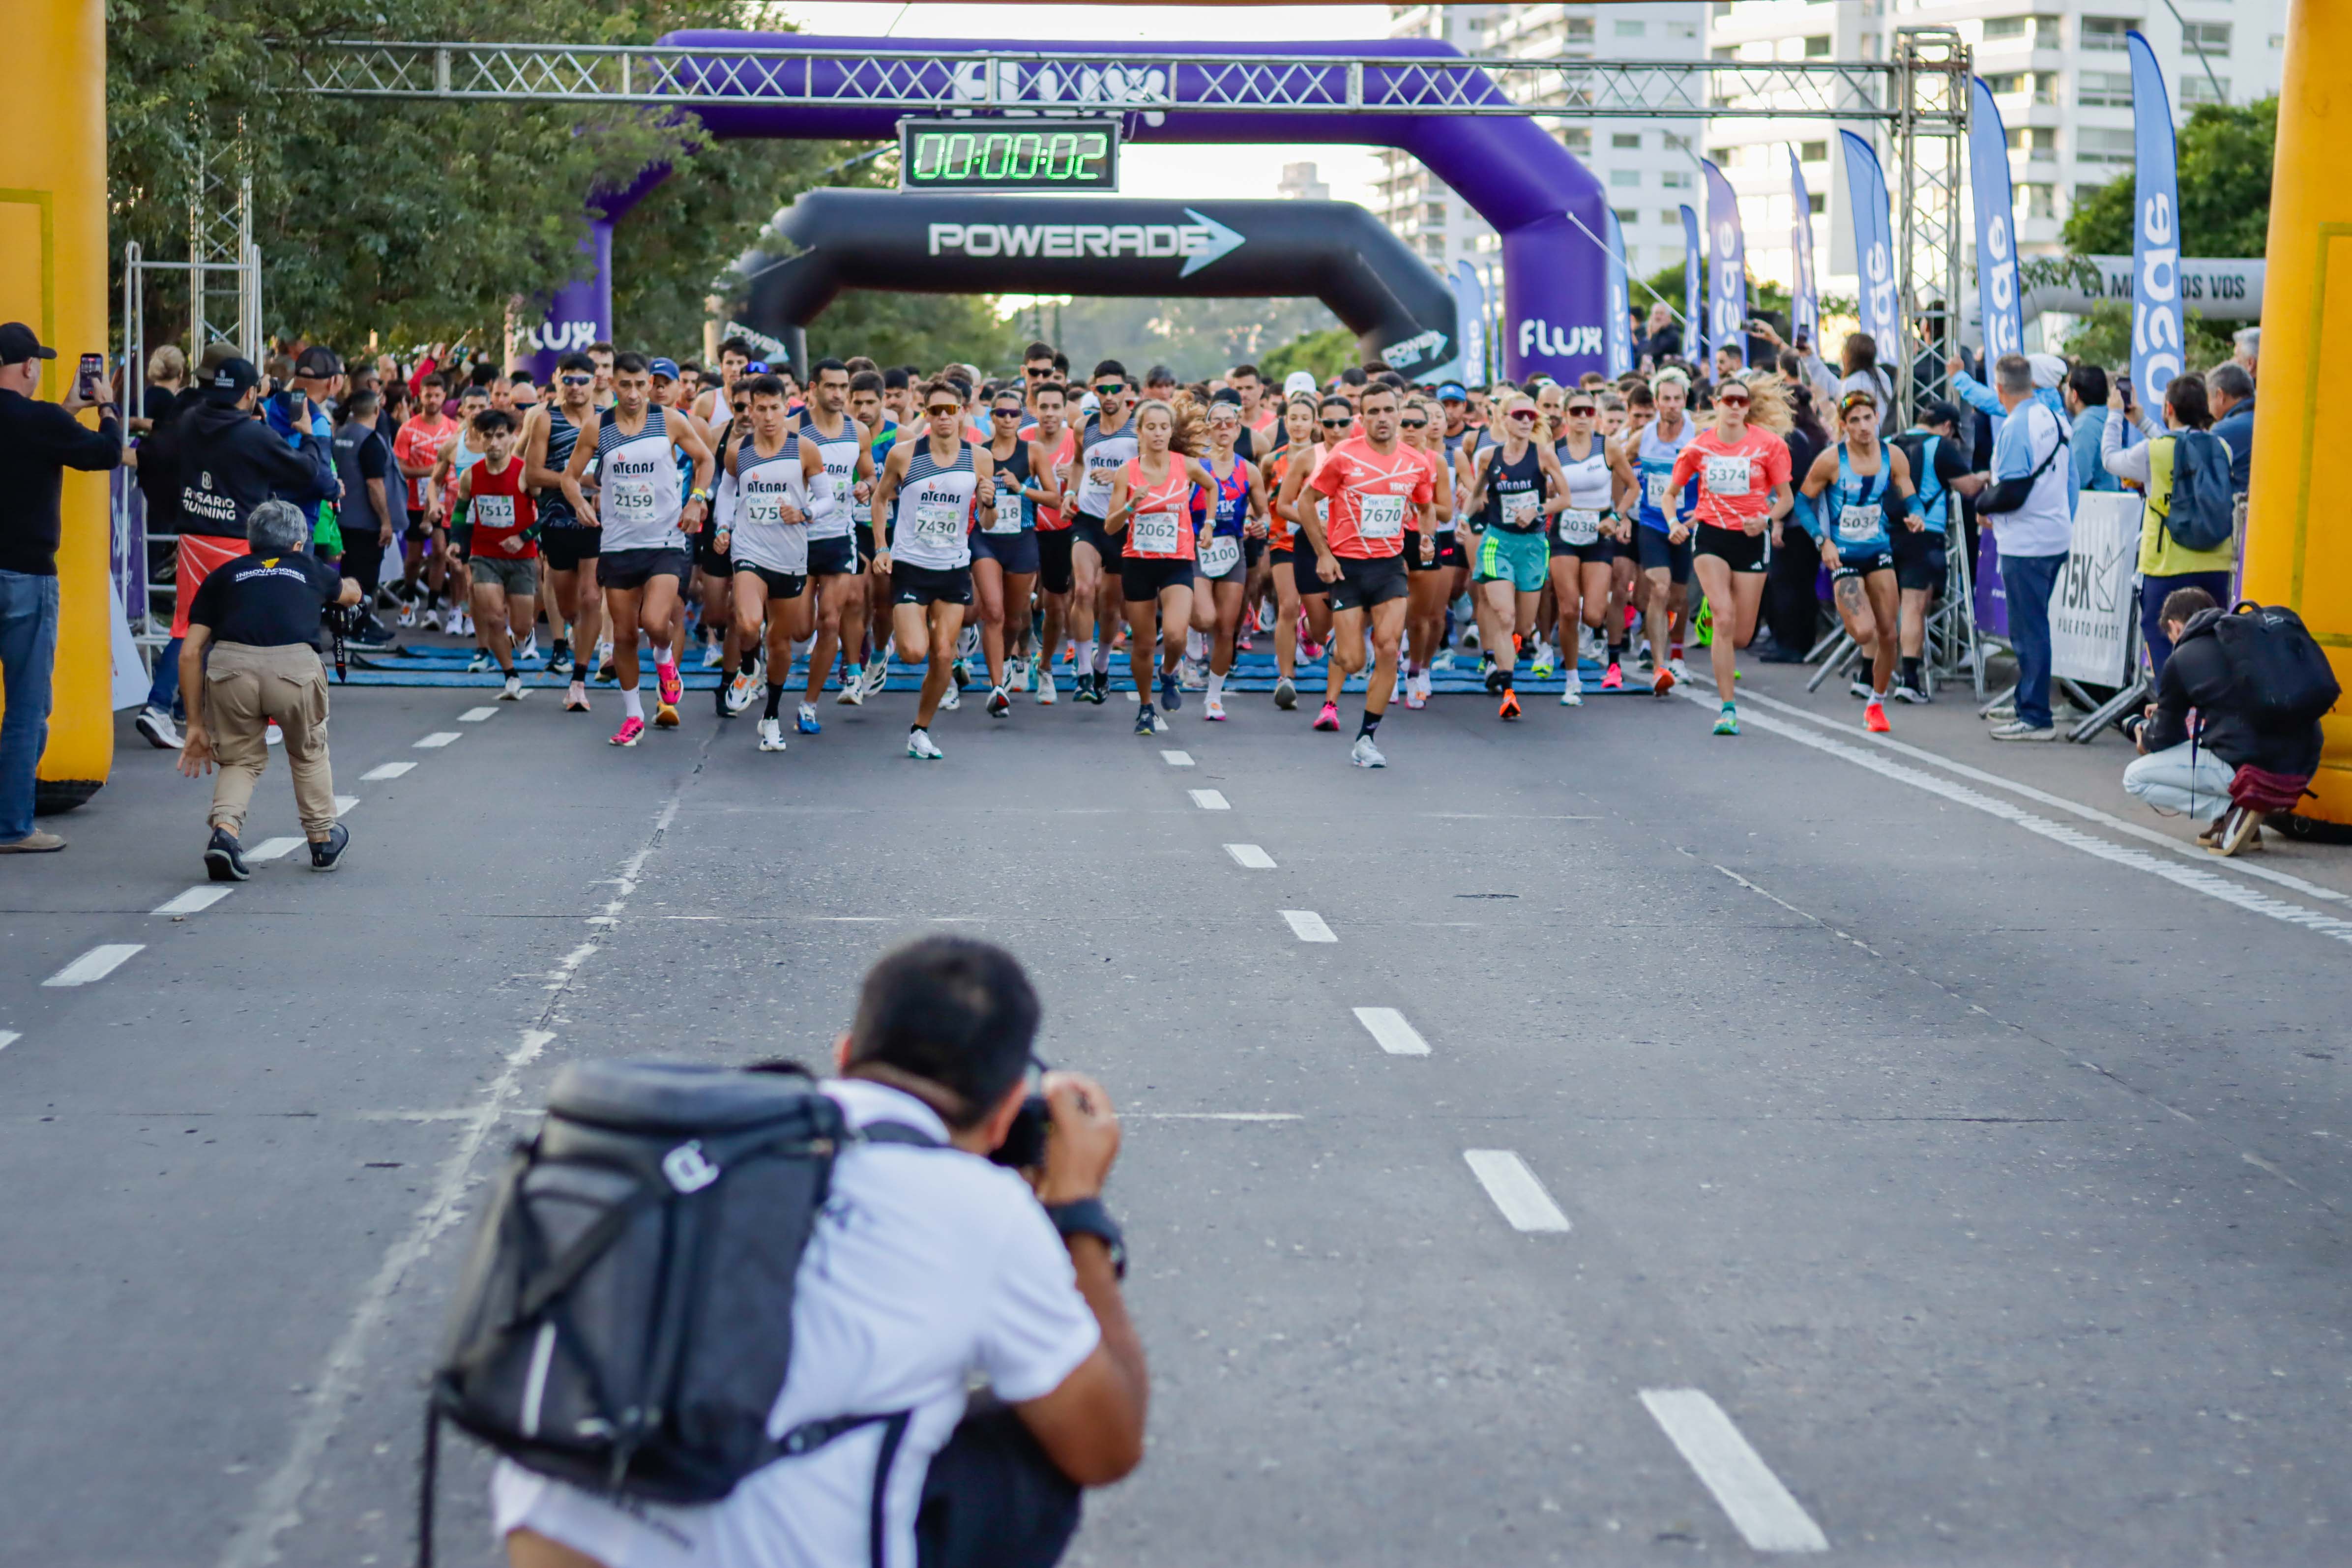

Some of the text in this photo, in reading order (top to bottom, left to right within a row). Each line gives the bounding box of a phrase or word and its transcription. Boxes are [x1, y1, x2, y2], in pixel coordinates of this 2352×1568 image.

[913, 133, 1108, 179] 00:00:02
[929, 223, 1209, 258] POWERADE
[2181, 274, 2203, 298] OS
[2210, 274, 2245, 298] VOS
[1518, 319, 1603, 358] flux
[613, 462, 654, 473] ATENAS
[1708, 469, 1747, 481] 5374
[748, 480, 787, 493] ATENAS
[184, 487, 235, 509] RSARIO
[615, 493, 653, 507] 2159
[920, 490, 961, 504] ATENAS
[478, 504, 512, 517] 7512
[749, 507, 778, 520] 175
[1364, 509, 1401, 522] 7670
[917, 519, 956, 534] 7430
[1136, 523, 1176, 538] 2062
[1562, 519, 1597, 533] 2038
[1202, 547, 1237, 564] 2100
[235, 567, 305, 580] INNOVACIONES
[2062, 553, 2093, 610] 15K
[2058, 617, 2091, 637] PUERTO
